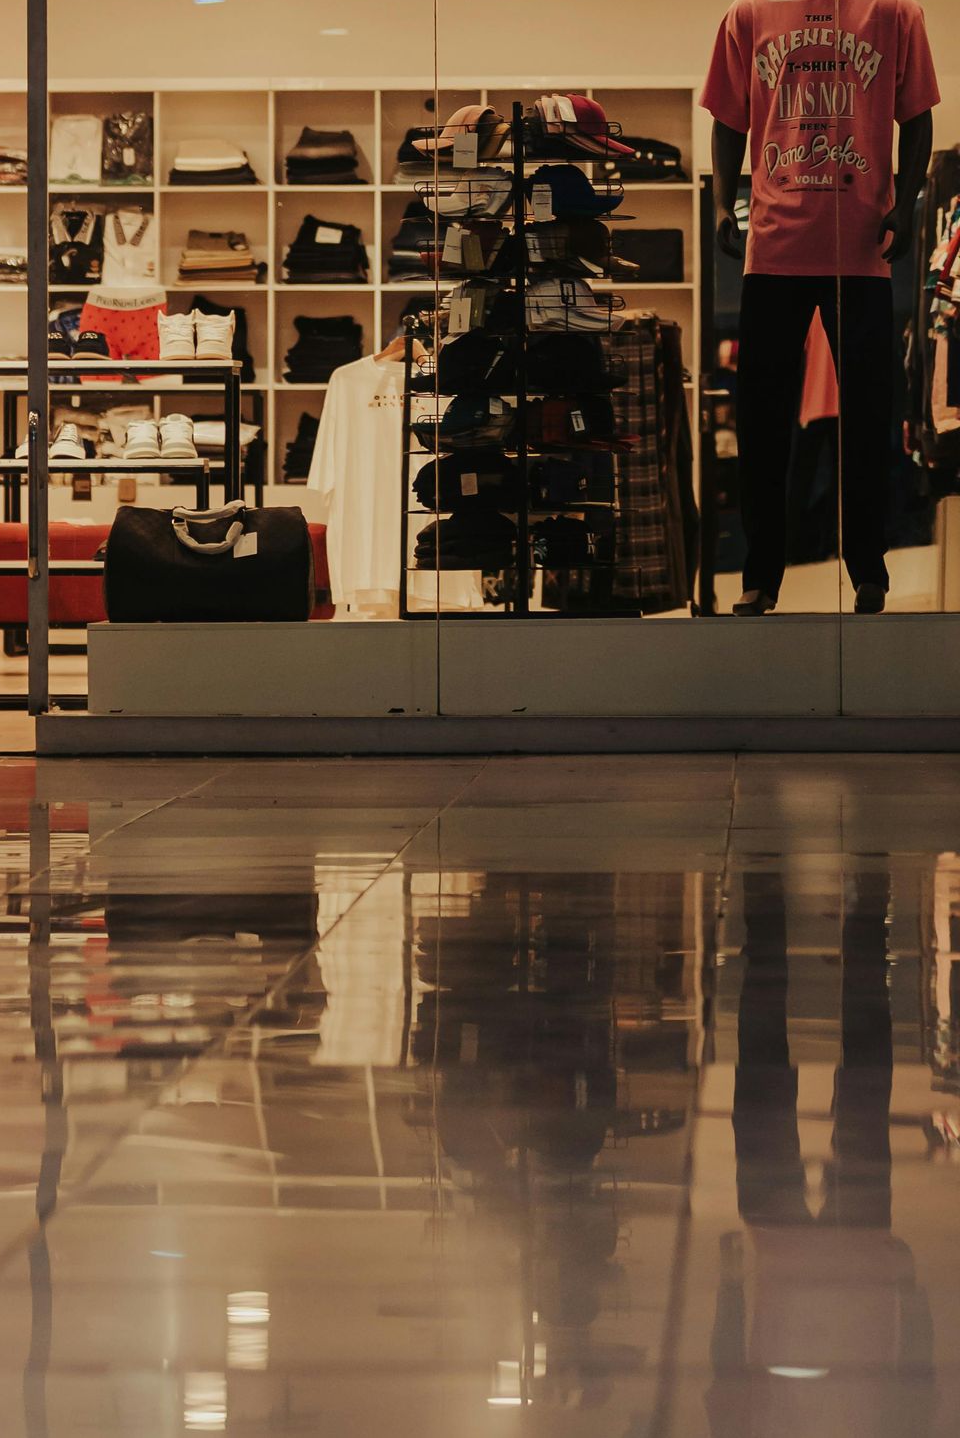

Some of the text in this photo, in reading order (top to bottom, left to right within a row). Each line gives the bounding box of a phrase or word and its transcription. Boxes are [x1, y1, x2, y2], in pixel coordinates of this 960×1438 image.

[805, 14, 833, 23] THIS
[755, 28, 884, 90] BALENCIAGA
[787, 61, 848, 72] T-SHIRT
[778, 80, 857, 118] HAS NOT
[799, 123, 828, 131] BEEN
[763, 134, 871, 179] Done Before
